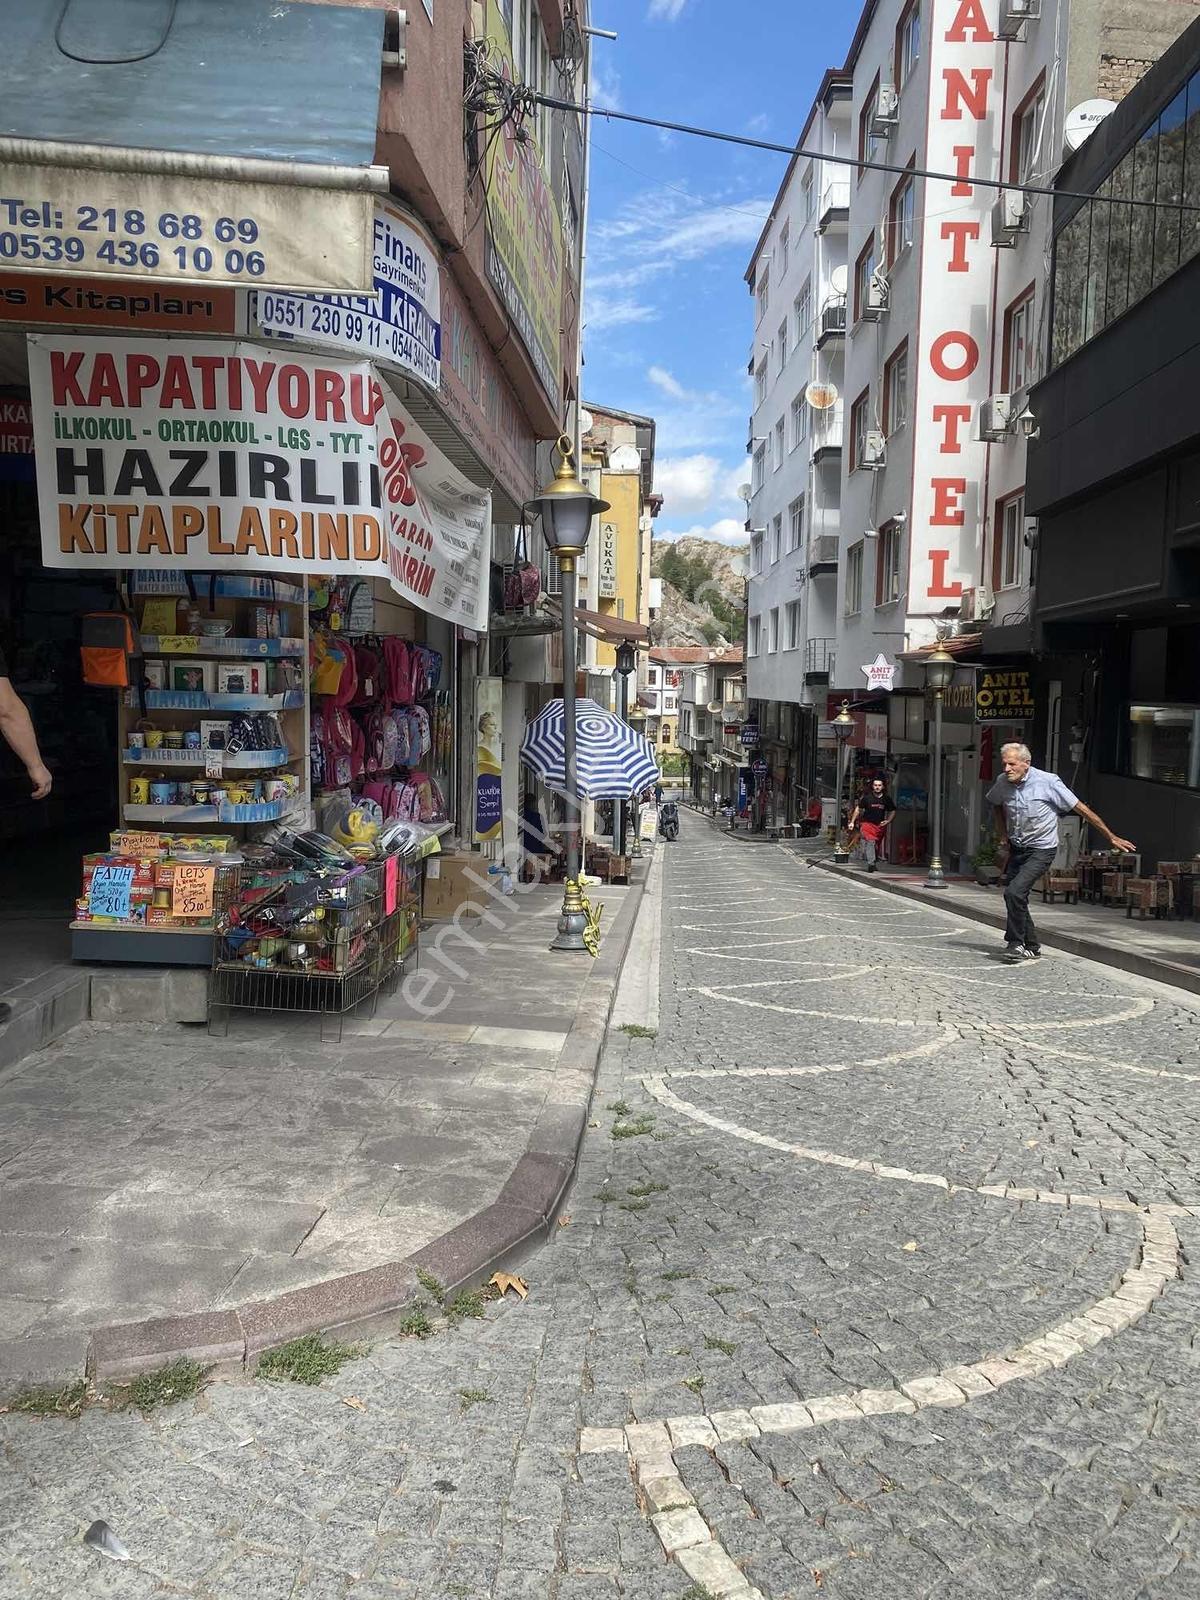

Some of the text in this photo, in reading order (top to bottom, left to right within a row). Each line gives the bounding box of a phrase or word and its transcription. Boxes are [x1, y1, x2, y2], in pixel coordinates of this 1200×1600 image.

[1, 199, 258, 244] Tel: 218 68 69
[0, 232, 265, 276] 0539 436 10 06
[373, 219, 427, 285] Finans
[45, 286, 213, 317] Kitapları
[927, 0, 994, 598] ANIT OTEL
[264, 295, 304, 328] 0551
[311, 305, 340, 336] 230
[345, 314, 363, 341] 99
[368, 320, 381, 348] 11
[392, 330, 412, 361] 0544
[391, 291, 437, 361] KİRALIK
[54, 412, 137, 442] İLKOKUL
[158, 418, 259, 445] ORTAOKUL
[278, 427, 311, 451] LGS
[330, 432, 363, 454] TYT
[604, 525, 613, 574] AVUKAT
[976, 688, 1034, 707] OTEL
[982, 672, 1030, 687] ANIT
[983, 709, 997, 717] 543
